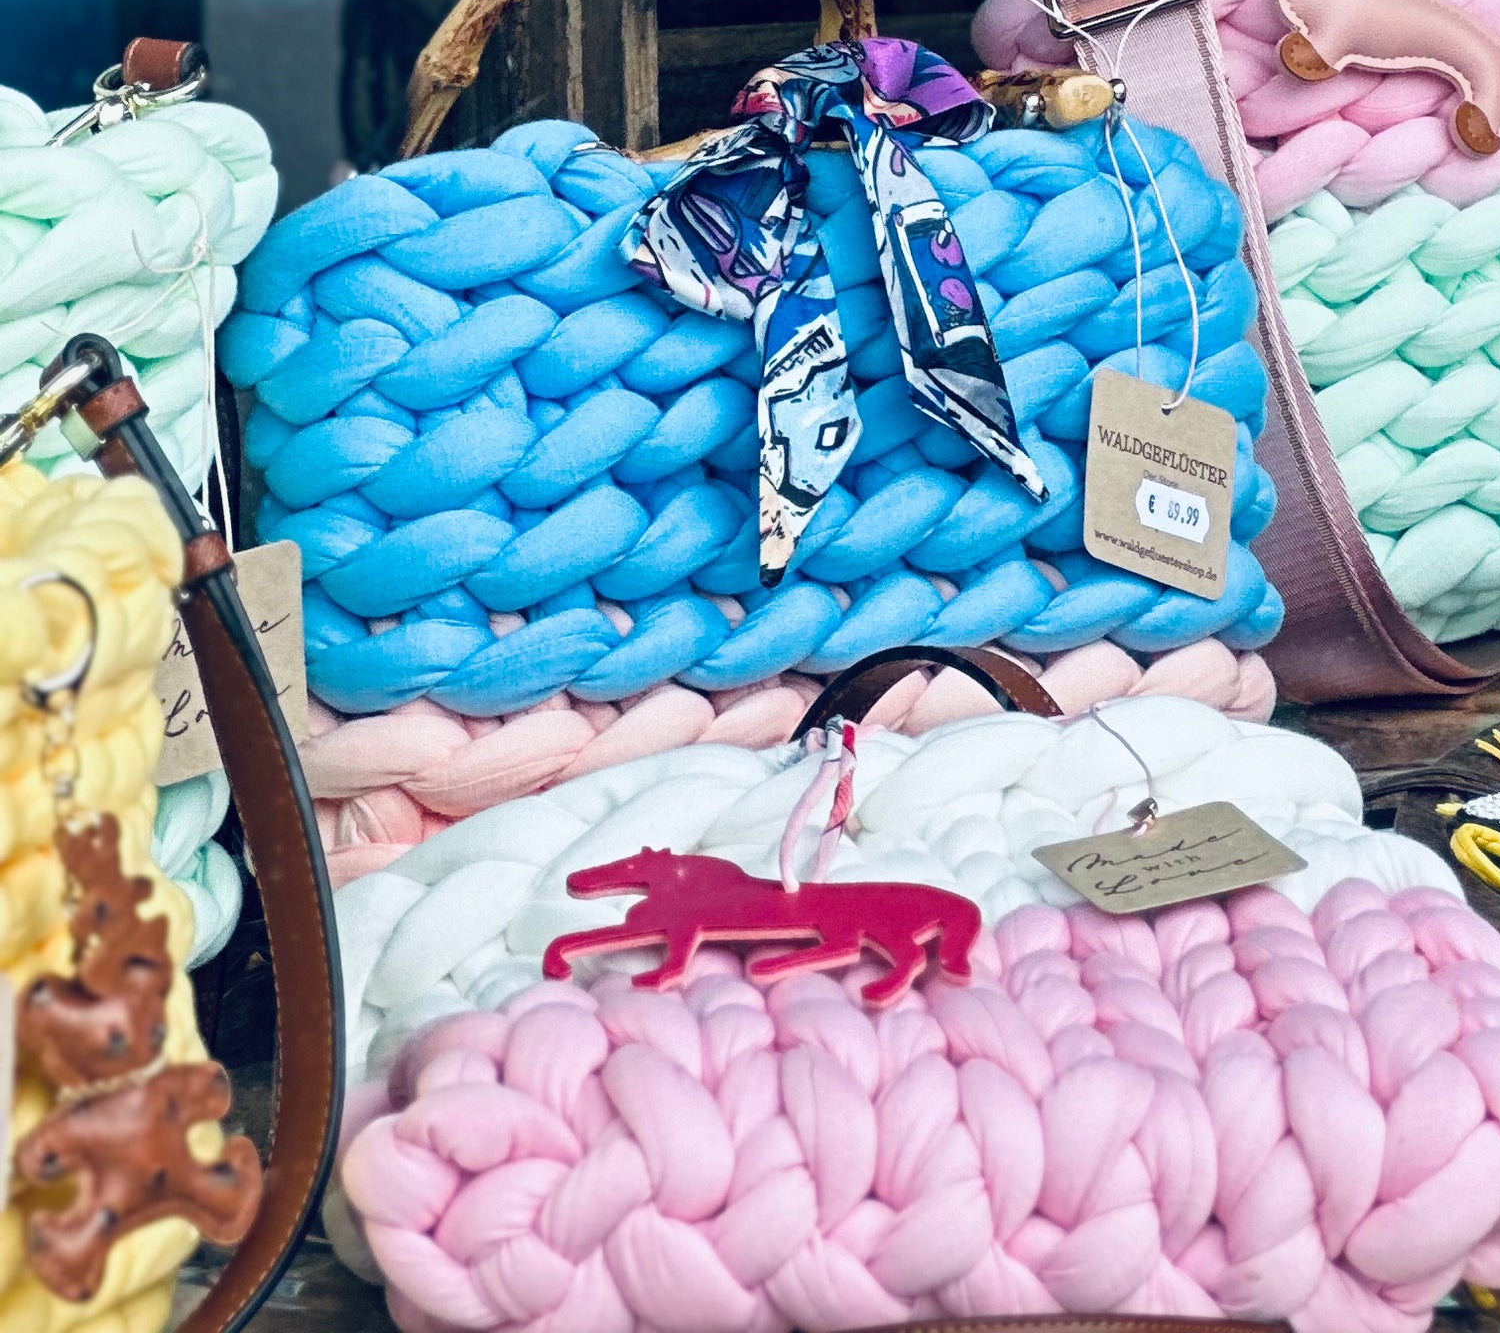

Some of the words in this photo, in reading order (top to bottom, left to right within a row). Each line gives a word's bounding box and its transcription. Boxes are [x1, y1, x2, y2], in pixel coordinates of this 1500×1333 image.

[1097, 424, 1228, 489] WALDGEFLÜSTER
[1148, 494, 1156, 514] €
[1094, 529, 1218, 582] www.waldgefluestershop.de
[1067, 827, 1244, 873] Made
[1095, 849, 1270, 897] Love
[1141, 854, 1203, 873] with
